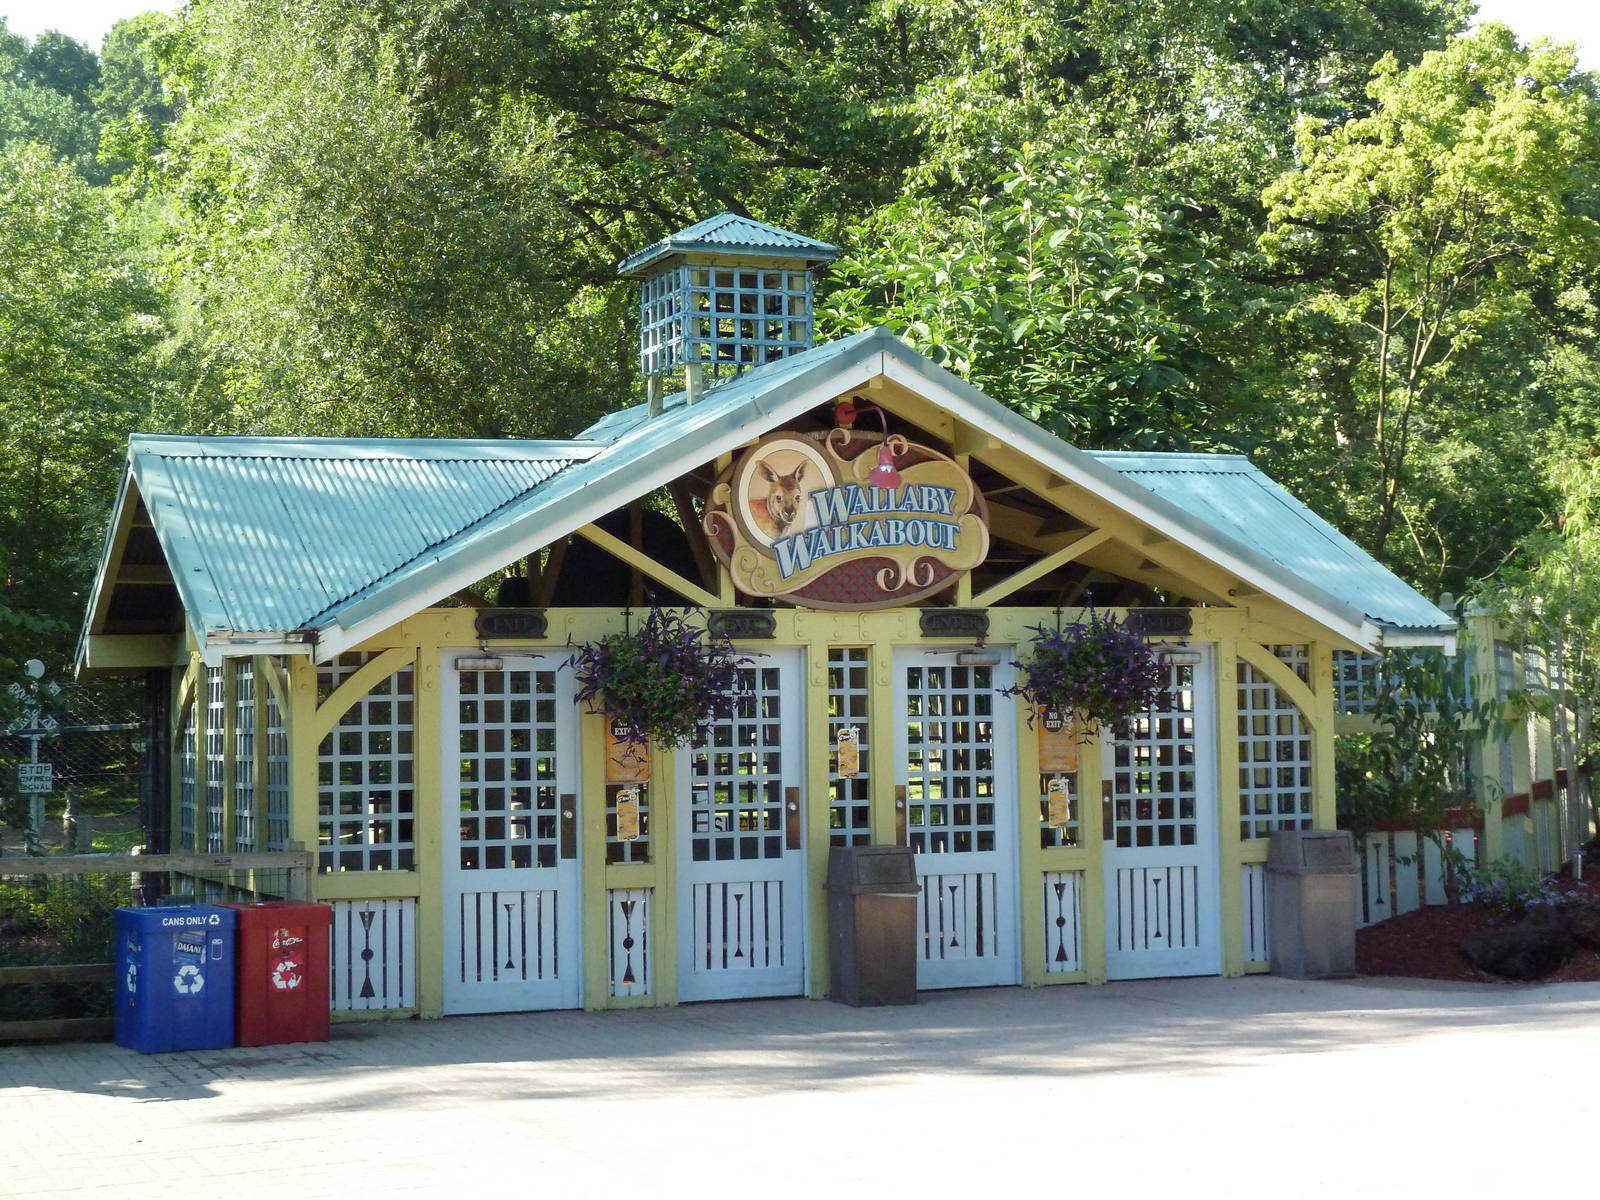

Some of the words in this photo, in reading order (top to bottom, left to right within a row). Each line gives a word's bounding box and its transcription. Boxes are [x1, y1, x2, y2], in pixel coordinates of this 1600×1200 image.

[809, 484, 957, 528] WALLABY
[771, 519, 960, 579] WALKABOUT
[1048, 711, 1058, 720] NO
[1045, 720, 1062, 728] EXIT
[20, 765, 51, 775] STOP
[162, 917, 185, 926] CANS
[186, 916, 207, 925] ONLY
